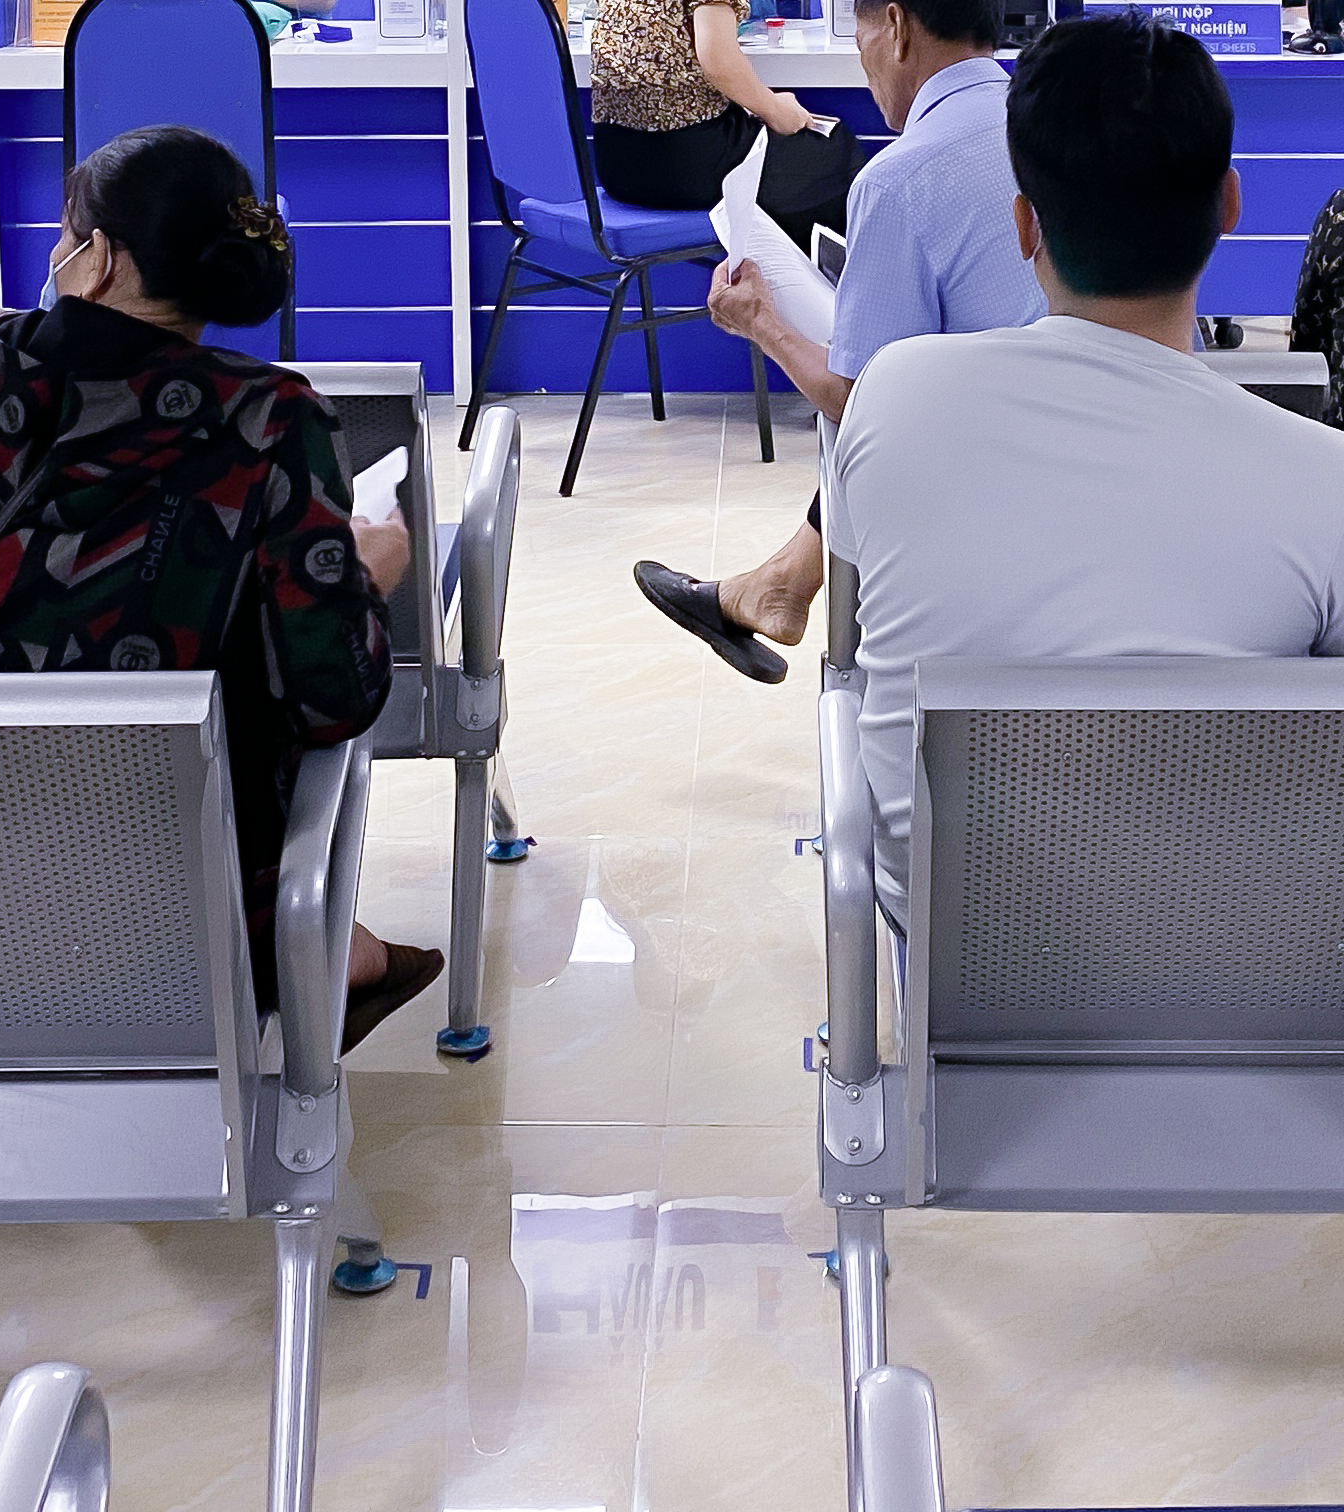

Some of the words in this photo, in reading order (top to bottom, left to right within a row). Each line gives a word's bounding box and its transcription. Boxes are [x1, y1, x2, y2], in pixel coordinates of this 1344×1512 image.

[1182, 4, 1214, 22] NỘP
[1190, 20, 1247, 38] NGHIỆM
[1221, 42, 1256, 54] SHEETS
